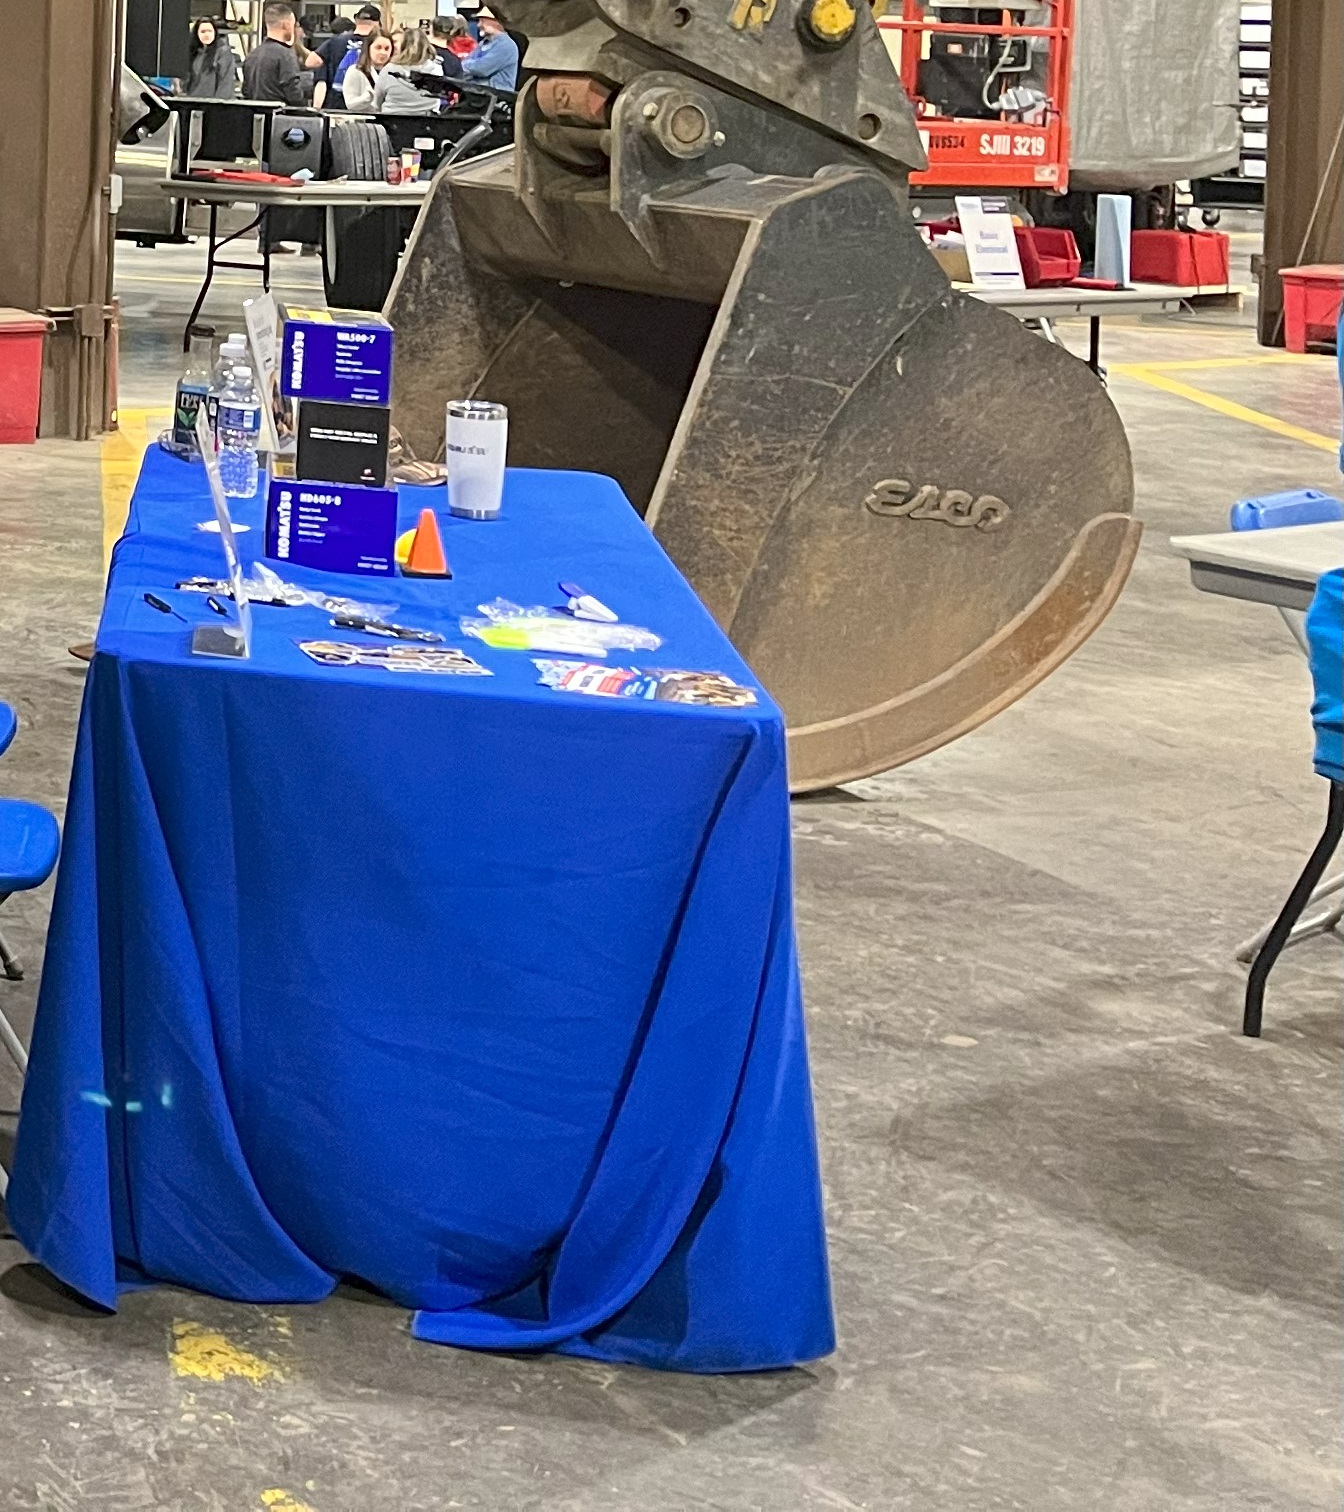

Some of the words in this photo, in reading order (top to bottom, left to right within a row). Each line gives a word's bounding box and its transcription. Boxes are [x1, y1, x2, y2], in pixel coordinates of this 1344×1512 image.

[1013, 135, 1045, 156] 3219
[291, 331, 305, 389] KOMATSU
[277, 491, 292, 558] KOMATSU
